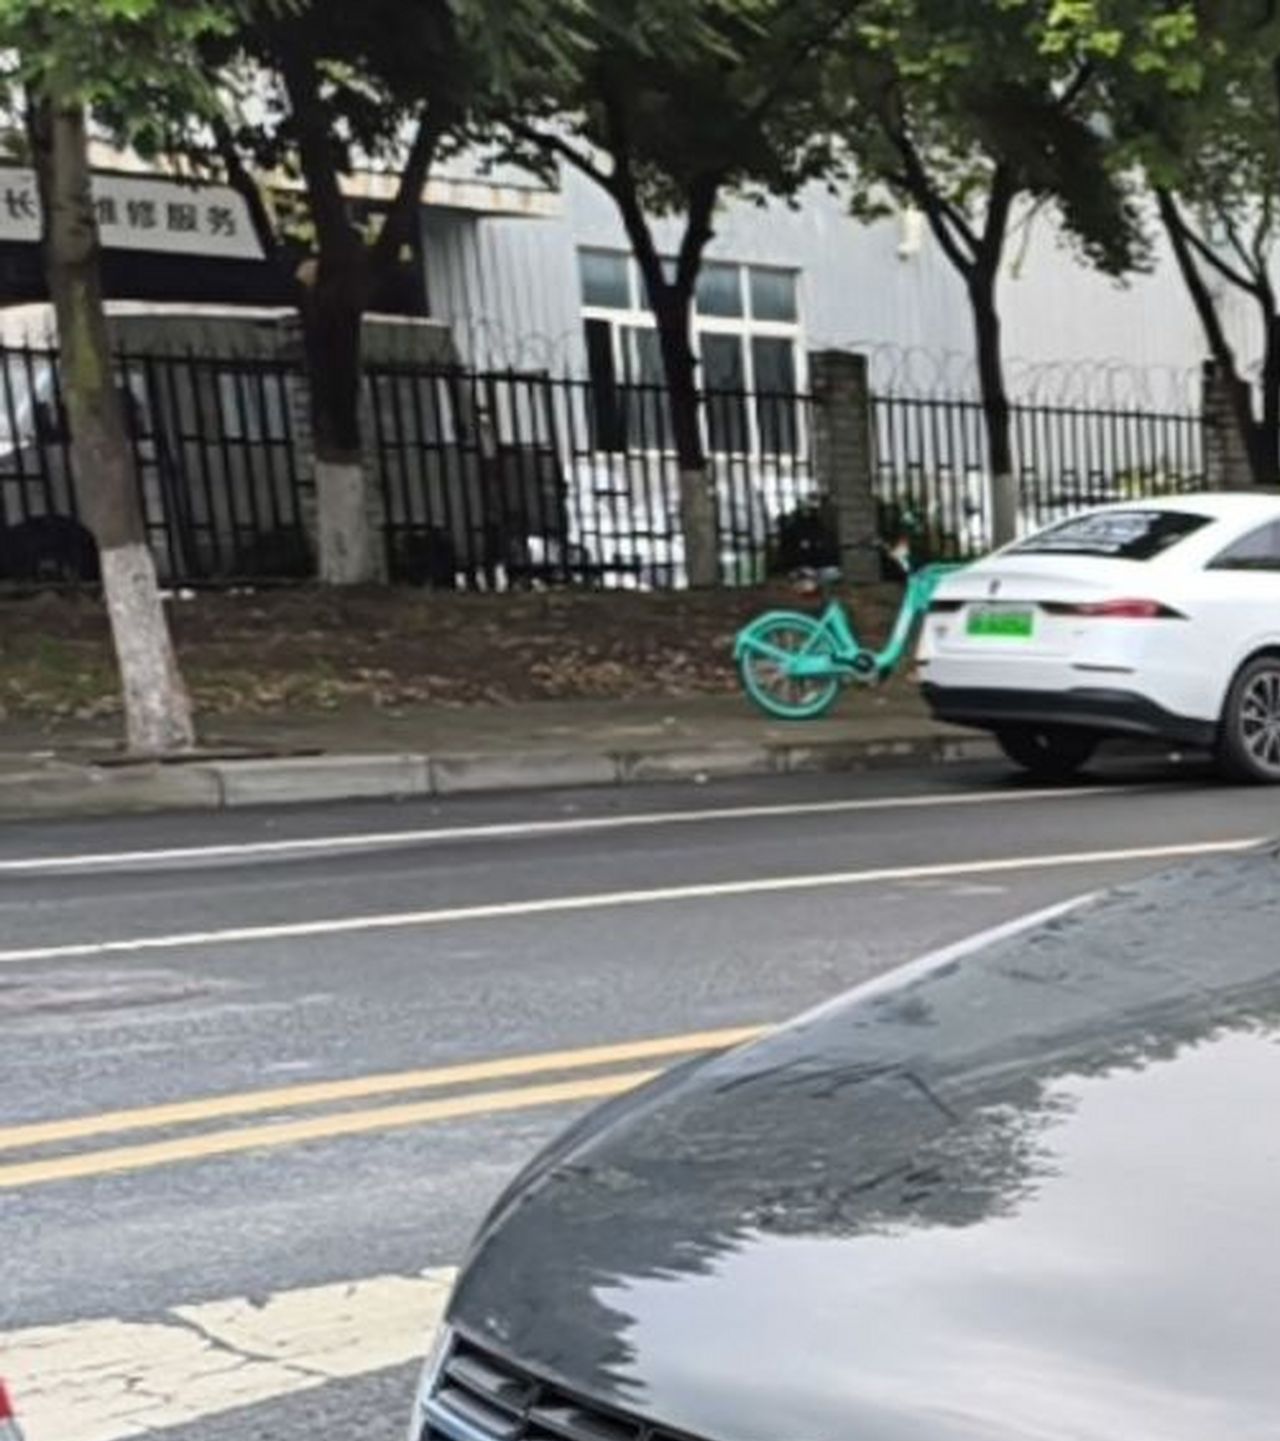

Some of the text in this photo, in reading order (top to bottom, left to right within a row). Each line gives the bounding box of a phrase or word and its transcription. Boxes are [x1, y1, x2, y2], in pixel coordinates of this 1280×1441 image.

[5, 187, 238, 237] 长维修服务
